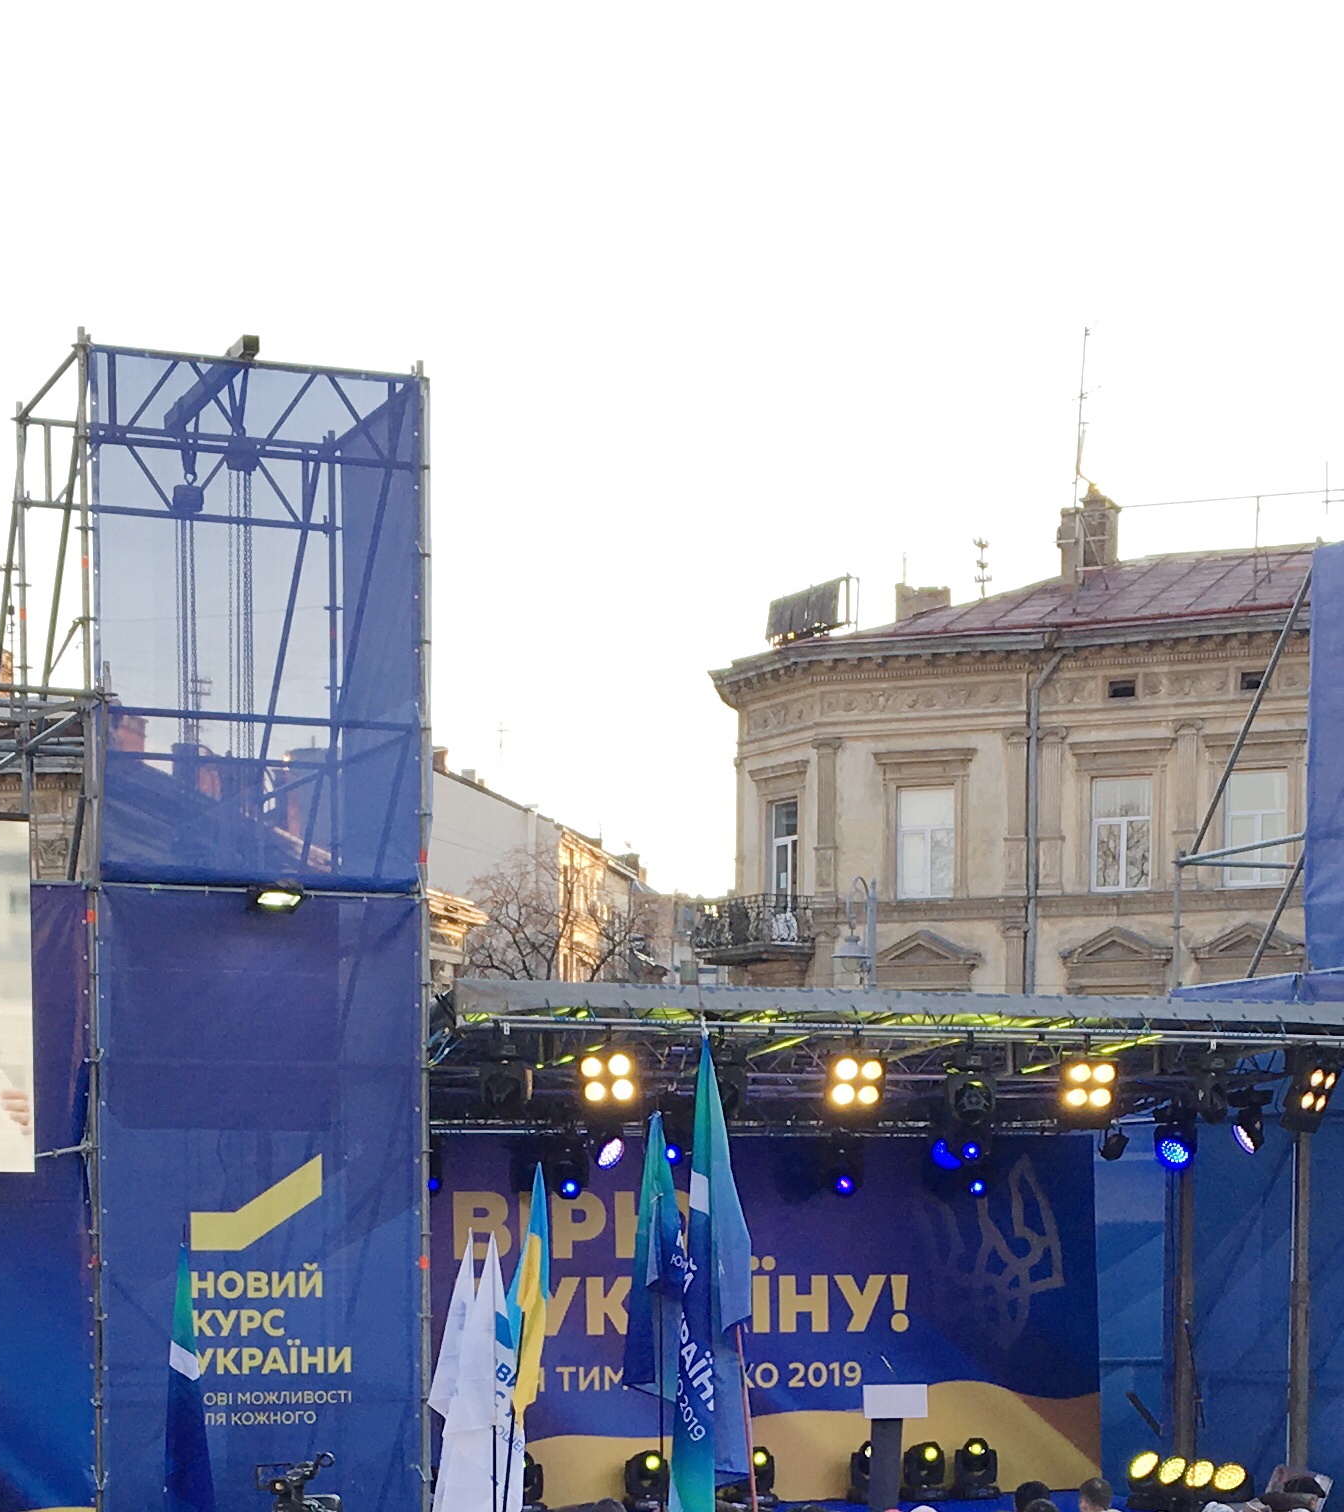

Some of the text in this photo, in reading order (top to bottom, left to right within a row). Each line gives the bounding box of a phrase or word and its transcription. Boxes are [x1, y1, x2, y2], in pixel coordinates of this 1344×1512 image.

[191, 1263, 323, 1299] НОВИЙ
[193, 1308, 285, 1337] КУРС
[196, 1338, 352, 1375] УКРАЇНИ
[788, 1361, 862, 1388] 2019
[203, 1389, 352, 1406] ОВІ МОЖЛИВОСТІ
[204, 1410, 317, 1426] ЛЯ КОЖНОГО
[679, 1395, 706, 1442] 2019
